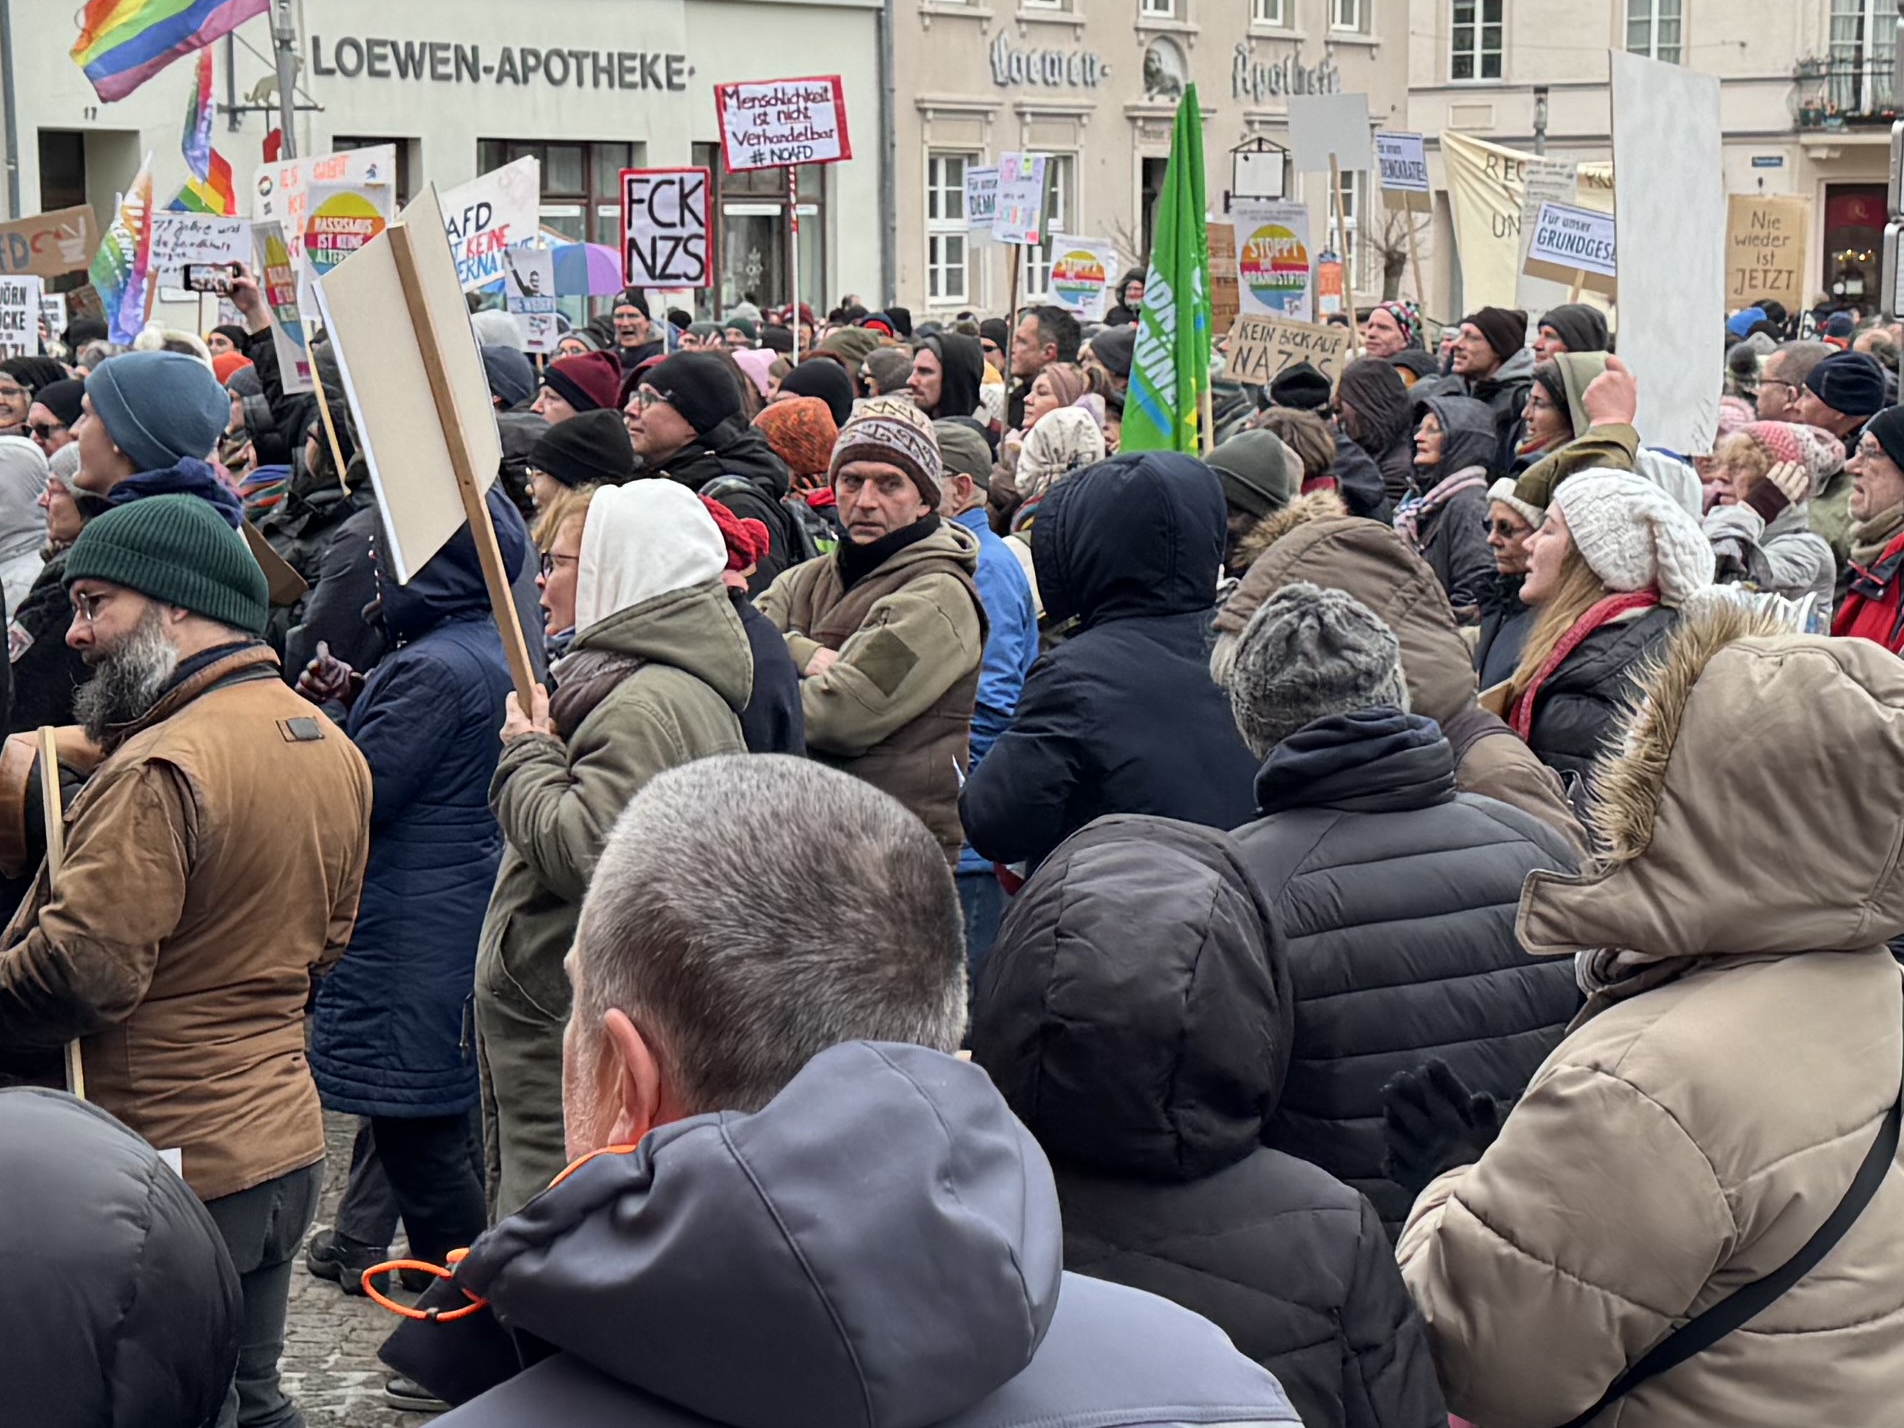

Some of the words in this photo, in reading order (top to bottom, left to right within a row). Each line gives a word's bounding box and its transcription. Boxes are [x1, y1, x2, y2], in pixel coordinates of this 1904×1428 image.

[724, 86, 831, 111] Menschlichkeit
[84, 106, 97, 121] 17
[753, 111, 770, 126] ist
[777, 106, 811, 123] nicht
[627, 177, 705, 230] FCK
[1751, 210, 1782, 231] Nie
[465, 224, 511, 258] KEINE
[1734, 233, 1791, 248] wieder
[627, 235, 705, 283] NZS
[1756, 250, 1775, 266] ist
[1733, 268, 1795, 296] JETZT
[1239, 321, 1276, 342] KEIN
[1312, 335, 1342, 354] AUF
